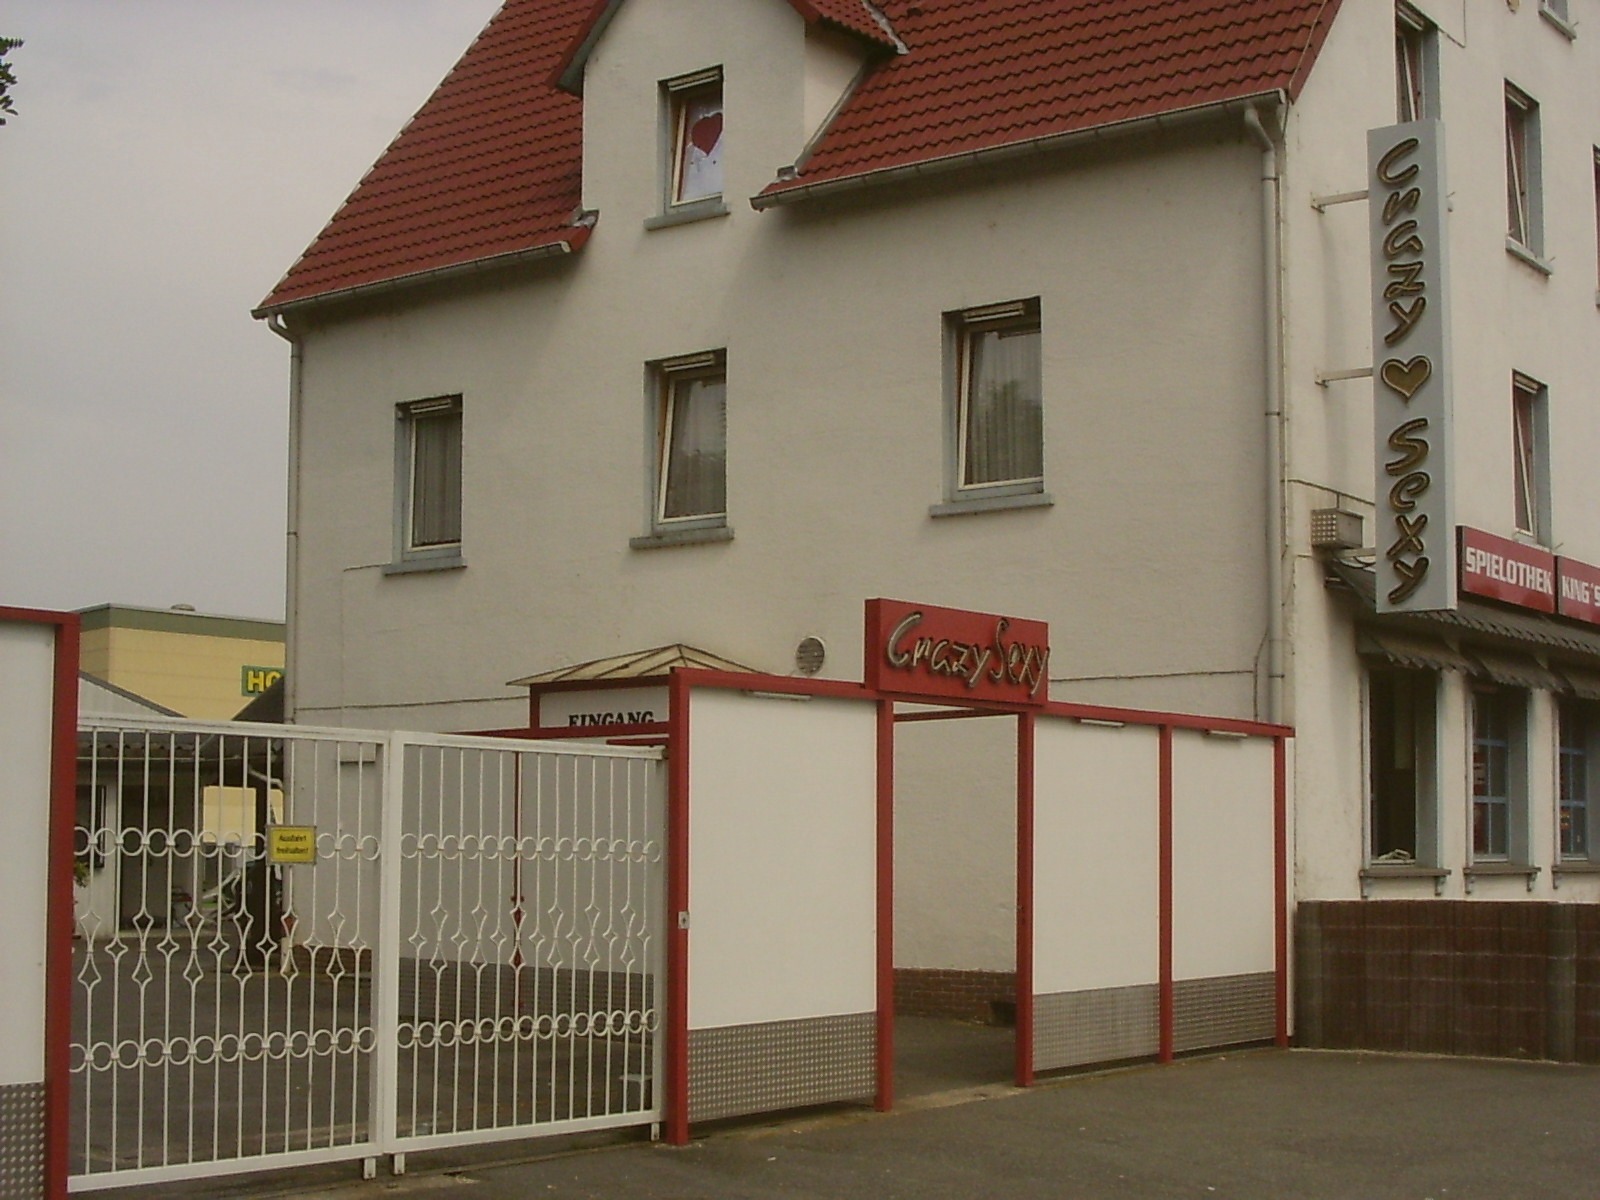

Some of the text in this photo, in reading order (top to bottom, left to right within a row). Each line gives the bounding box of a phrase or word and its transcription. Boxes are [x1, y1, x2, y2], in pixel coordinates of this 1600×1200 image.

[1385, 417, 1431, 604] Sexy
[1465, 546, 1553, 595] SPIELOTHEK
[887, 611, 1050, 697] Crazy Sexy
